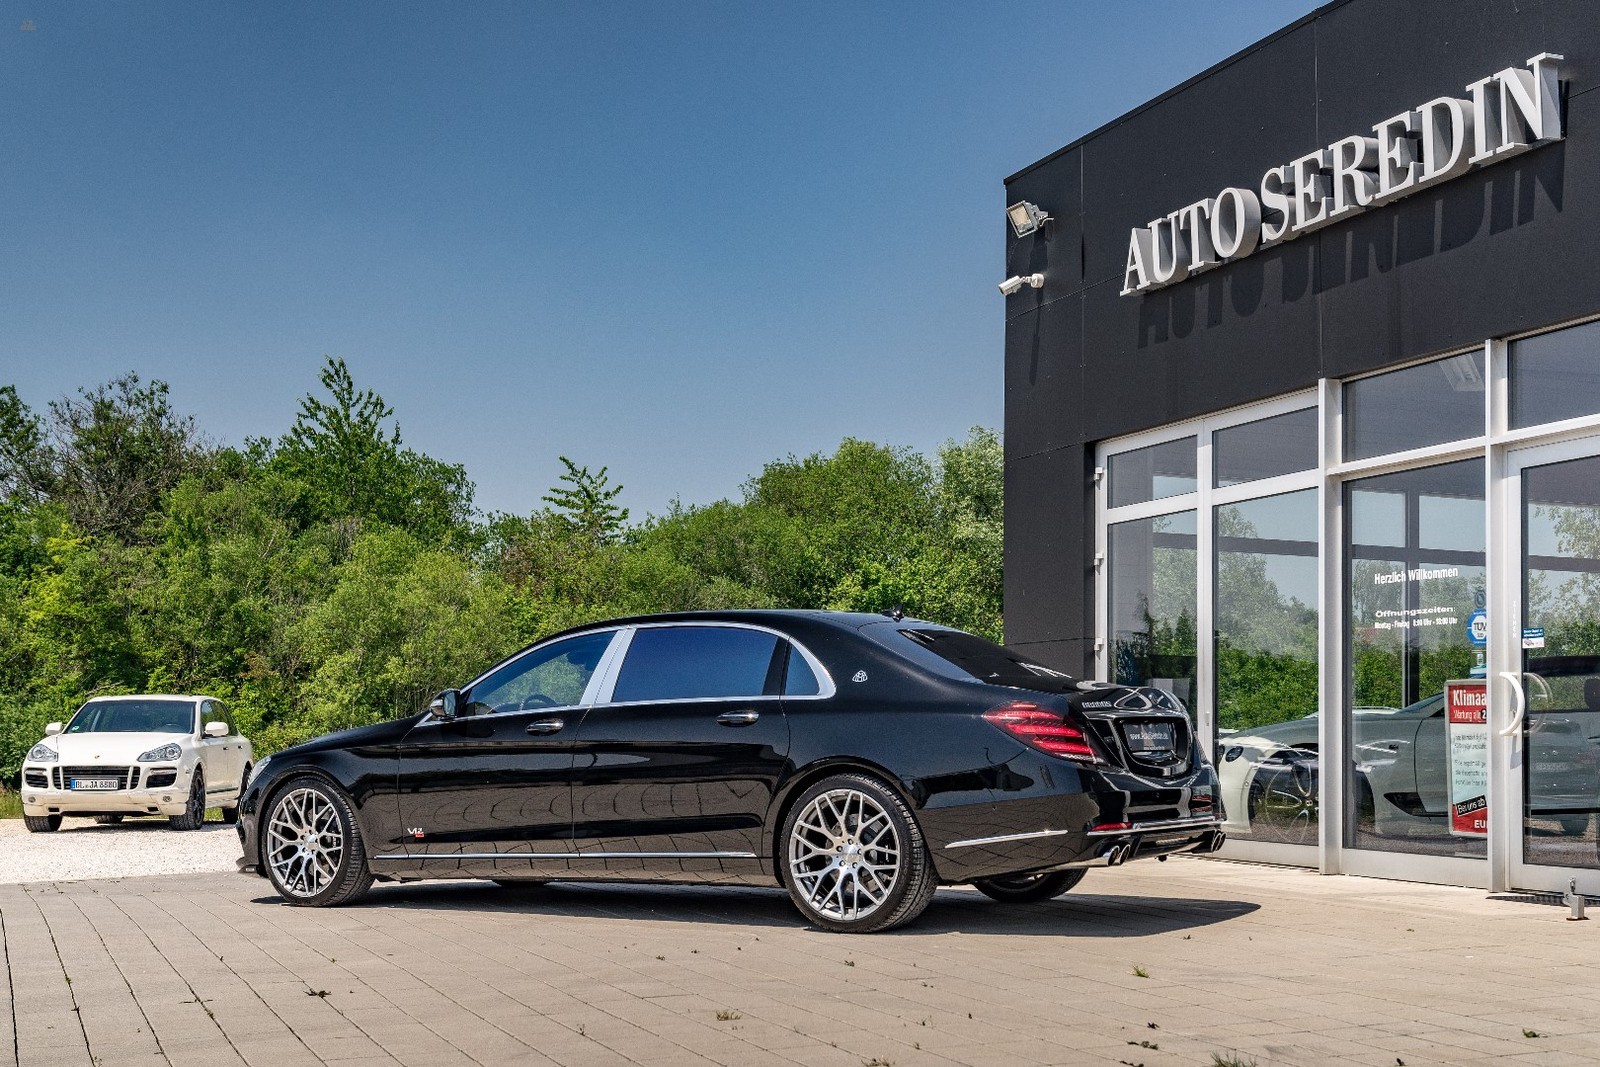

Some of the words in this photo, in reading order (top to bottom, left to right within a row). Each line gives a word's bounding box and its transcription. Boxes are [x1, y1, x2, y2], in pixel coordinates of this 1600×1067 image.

[1120, 187, 1261, 296] AUTO
[1260, 53, 1564, 244] SEREDIN
[1374, 571, 1406, 585] Herzlich
[1408, 568, 1458, 581] Willkommen
[1477, 798, 1485, 807] ab
[1474, 819, 1488, 829] EU
